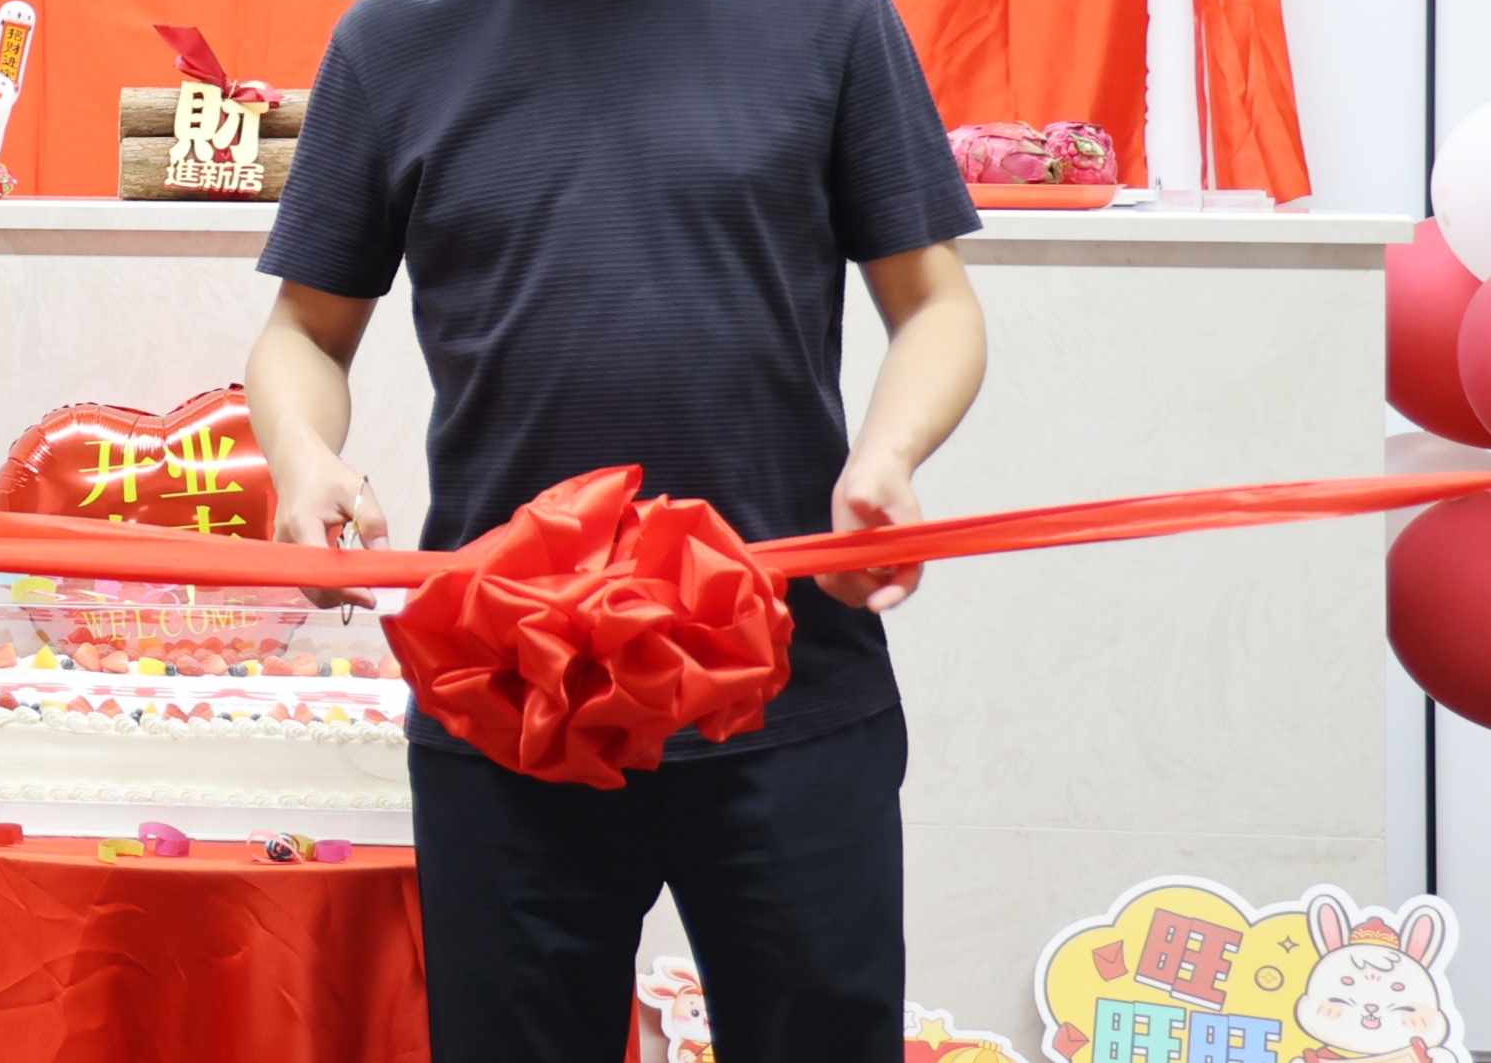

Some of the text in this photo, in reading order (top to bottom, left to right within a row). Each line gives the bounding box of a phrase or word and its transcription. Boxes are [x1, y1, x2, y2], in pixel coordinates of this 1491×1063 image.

[169, 80, 270, 165] 財
[164, 158, 265, 192] 進新居
[78, 426, 244, 508] 开业
[82, 600, 259, 642] WELCOME
[1134, 908, 1244, 1012] 旺
